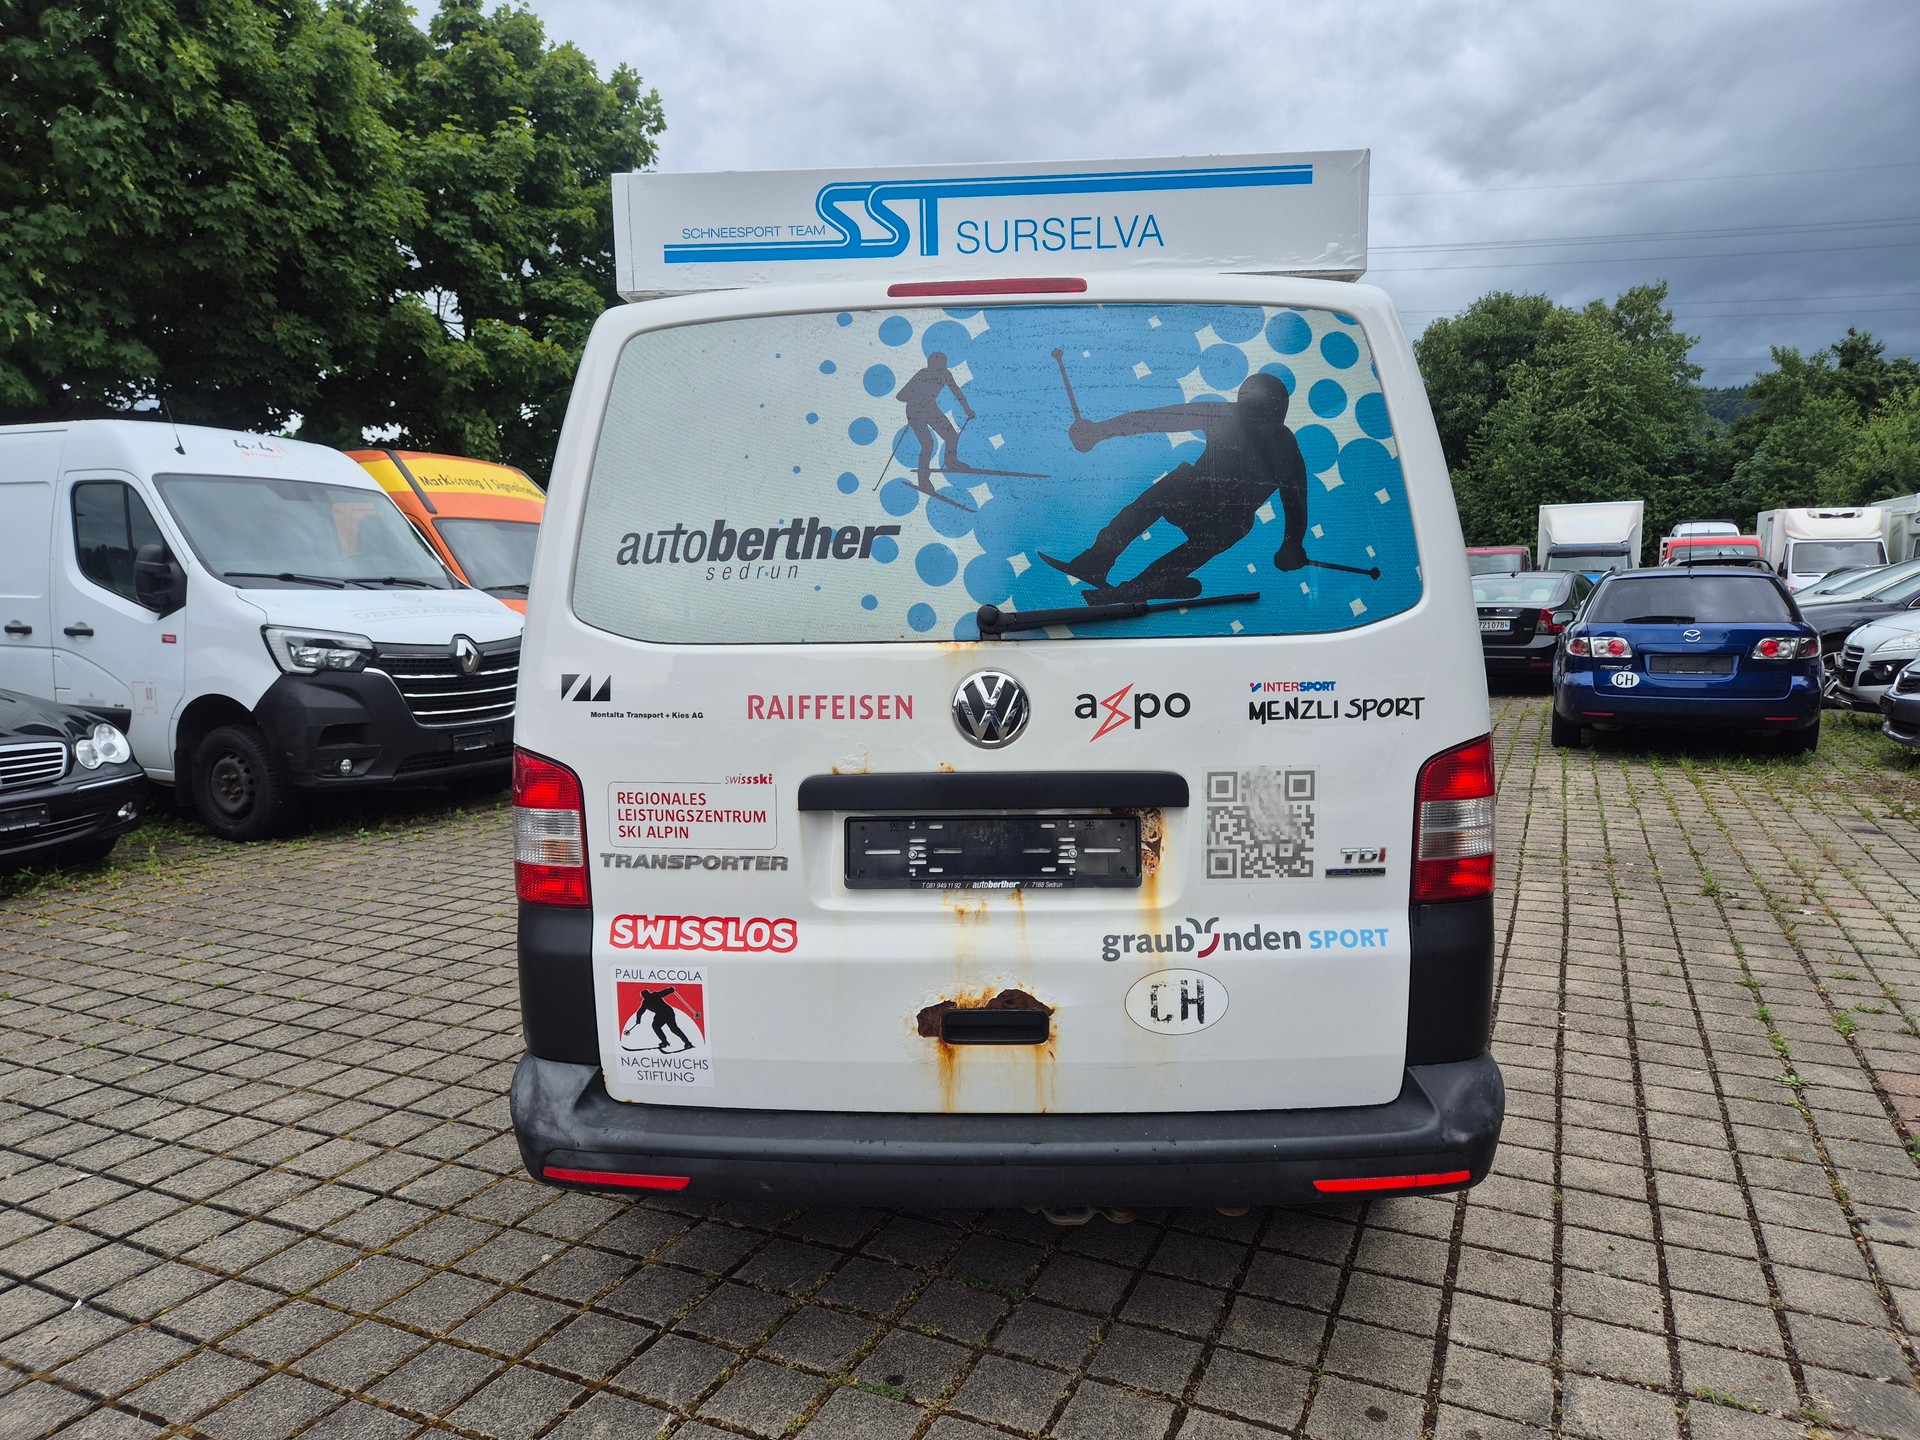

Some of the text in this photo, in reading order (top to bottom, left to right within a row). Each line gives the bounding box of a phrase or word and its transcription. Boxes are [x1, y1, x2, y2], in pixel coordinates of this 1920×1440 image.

[815, 181, 939, 259] SST
[682, 225, 826, 240] SCHNEESPORT TEAM
[956, 214, 1165, 254] SURSELVA
[419, 473, 486, 490] Markierung
[616, 517, 902, 566] autoberther
[705, 562, 799, 581] sedrun
[1263, 681, 1336, 693] INTERSPORT
[1615, 673, 1634, 686] CH
[590, 711, 625, 719] Montalta
[626, 711, 664, 720] Transport
[671, 711, 690, 719] Kies
[691, 711, 704, 719] AG
[747, 694, 914, 721] RAIFFEISEN
[1249, 696, 1426, 725] MENZLI SPORT
[617, 791, 707, 806] REGIONALES
[617, 808, 767, 823] LEISTUNGSZENTRUM
[618, 825, 690, 839] SKI ALPIN
[600, 852, 789, 871] TRANSPORTER
[1340, 847, 1387, 864] TDI
[972, 880, 1021, 889] autoberther
[610, 914, 798, 952] SWISSLOS
[1309, 928, 1390, 950] SPORT
[615, 968, 703, 981] PAUL ACCOLA
[1150, 978, 1205, 1025] CH
[620, 1056, 710, 1071] NACHWUCHS
[637, 1070, 696, 1083] STIFTUNG
